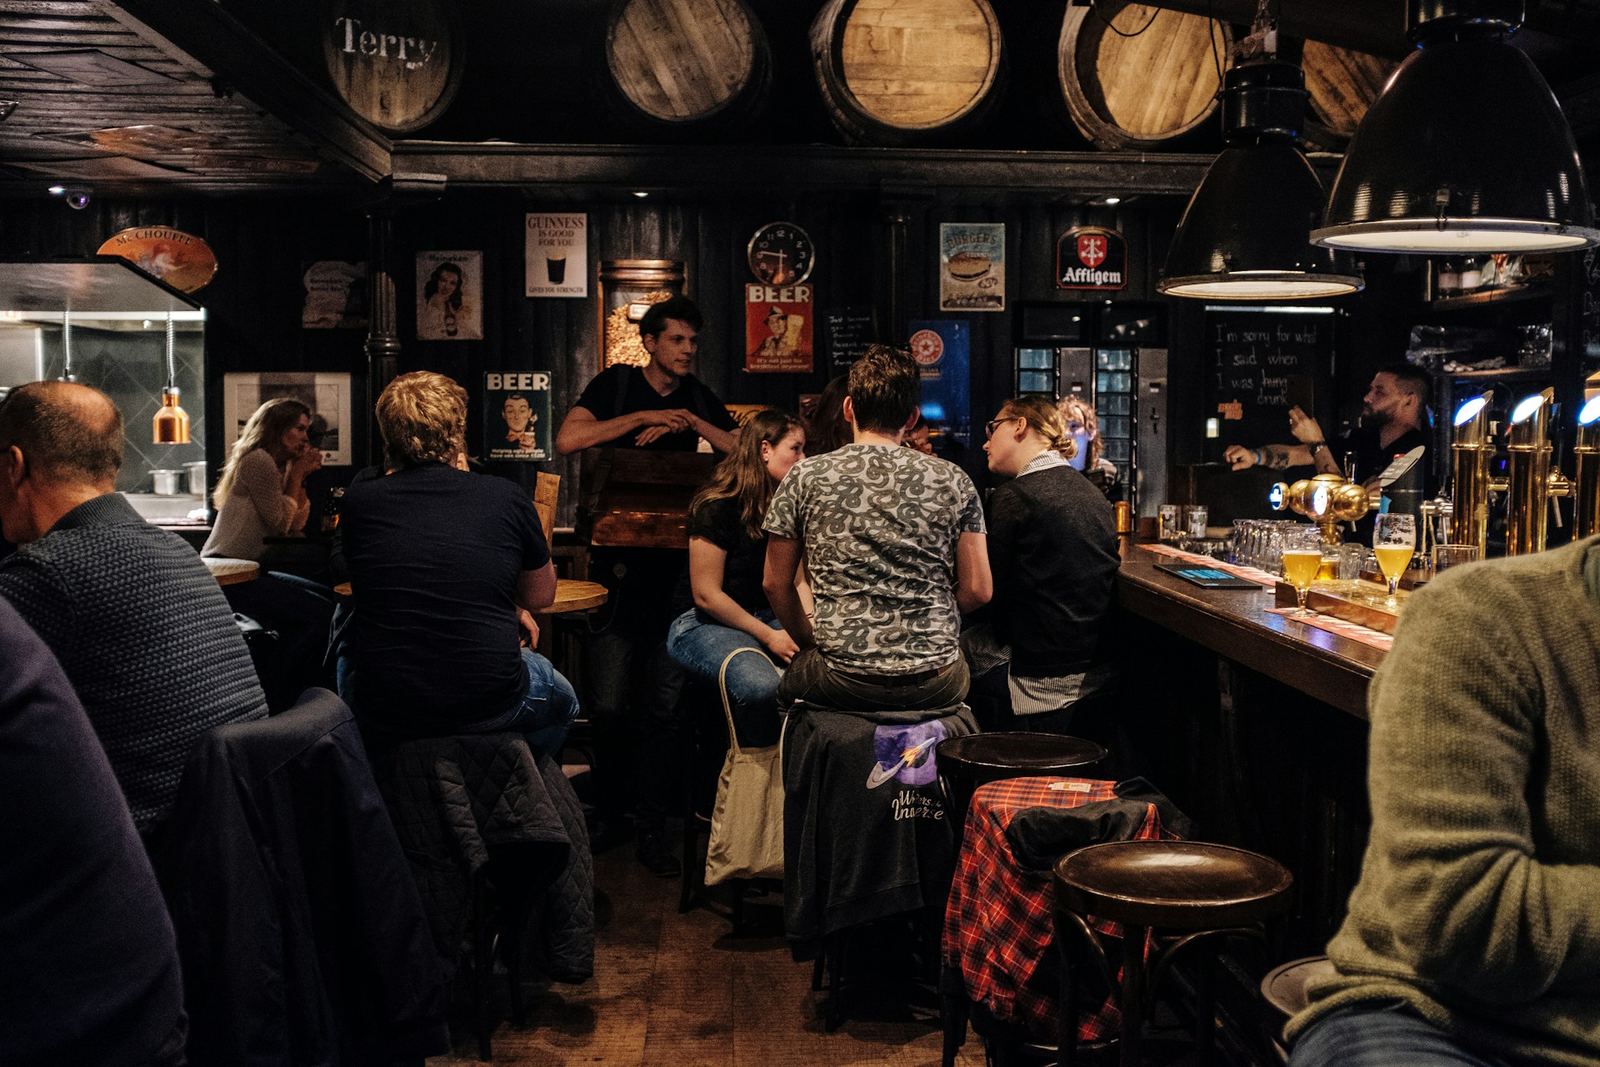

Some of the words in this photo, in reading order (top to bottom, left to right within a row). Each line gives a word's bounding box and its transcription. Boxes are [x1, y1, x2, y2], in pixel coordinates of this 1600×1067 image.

[335, 17, 437, 62] Terry
[528, 216, 584, 229] GUINNESS
[135, 230, 193, 246] CHOUFFE
[539, 229, 547, 238] IS
[548, 229, 575, 238] GOOD
[539, 239, 555, 247] FOR
[557, 239, 575, 247] YOU
[1062, 267, 1121, 286] Affligem
[748, 286, 810, 302] BEER
[1243, 331, 1271, 347] sorry
[1276, 323, 1290, 341] for
[1233, 345, 1257, 366] said
[1267, 347, 1298, 366] when
[487, 373, 548, 391] BEER
[1232, 379, 1254, 390] was
